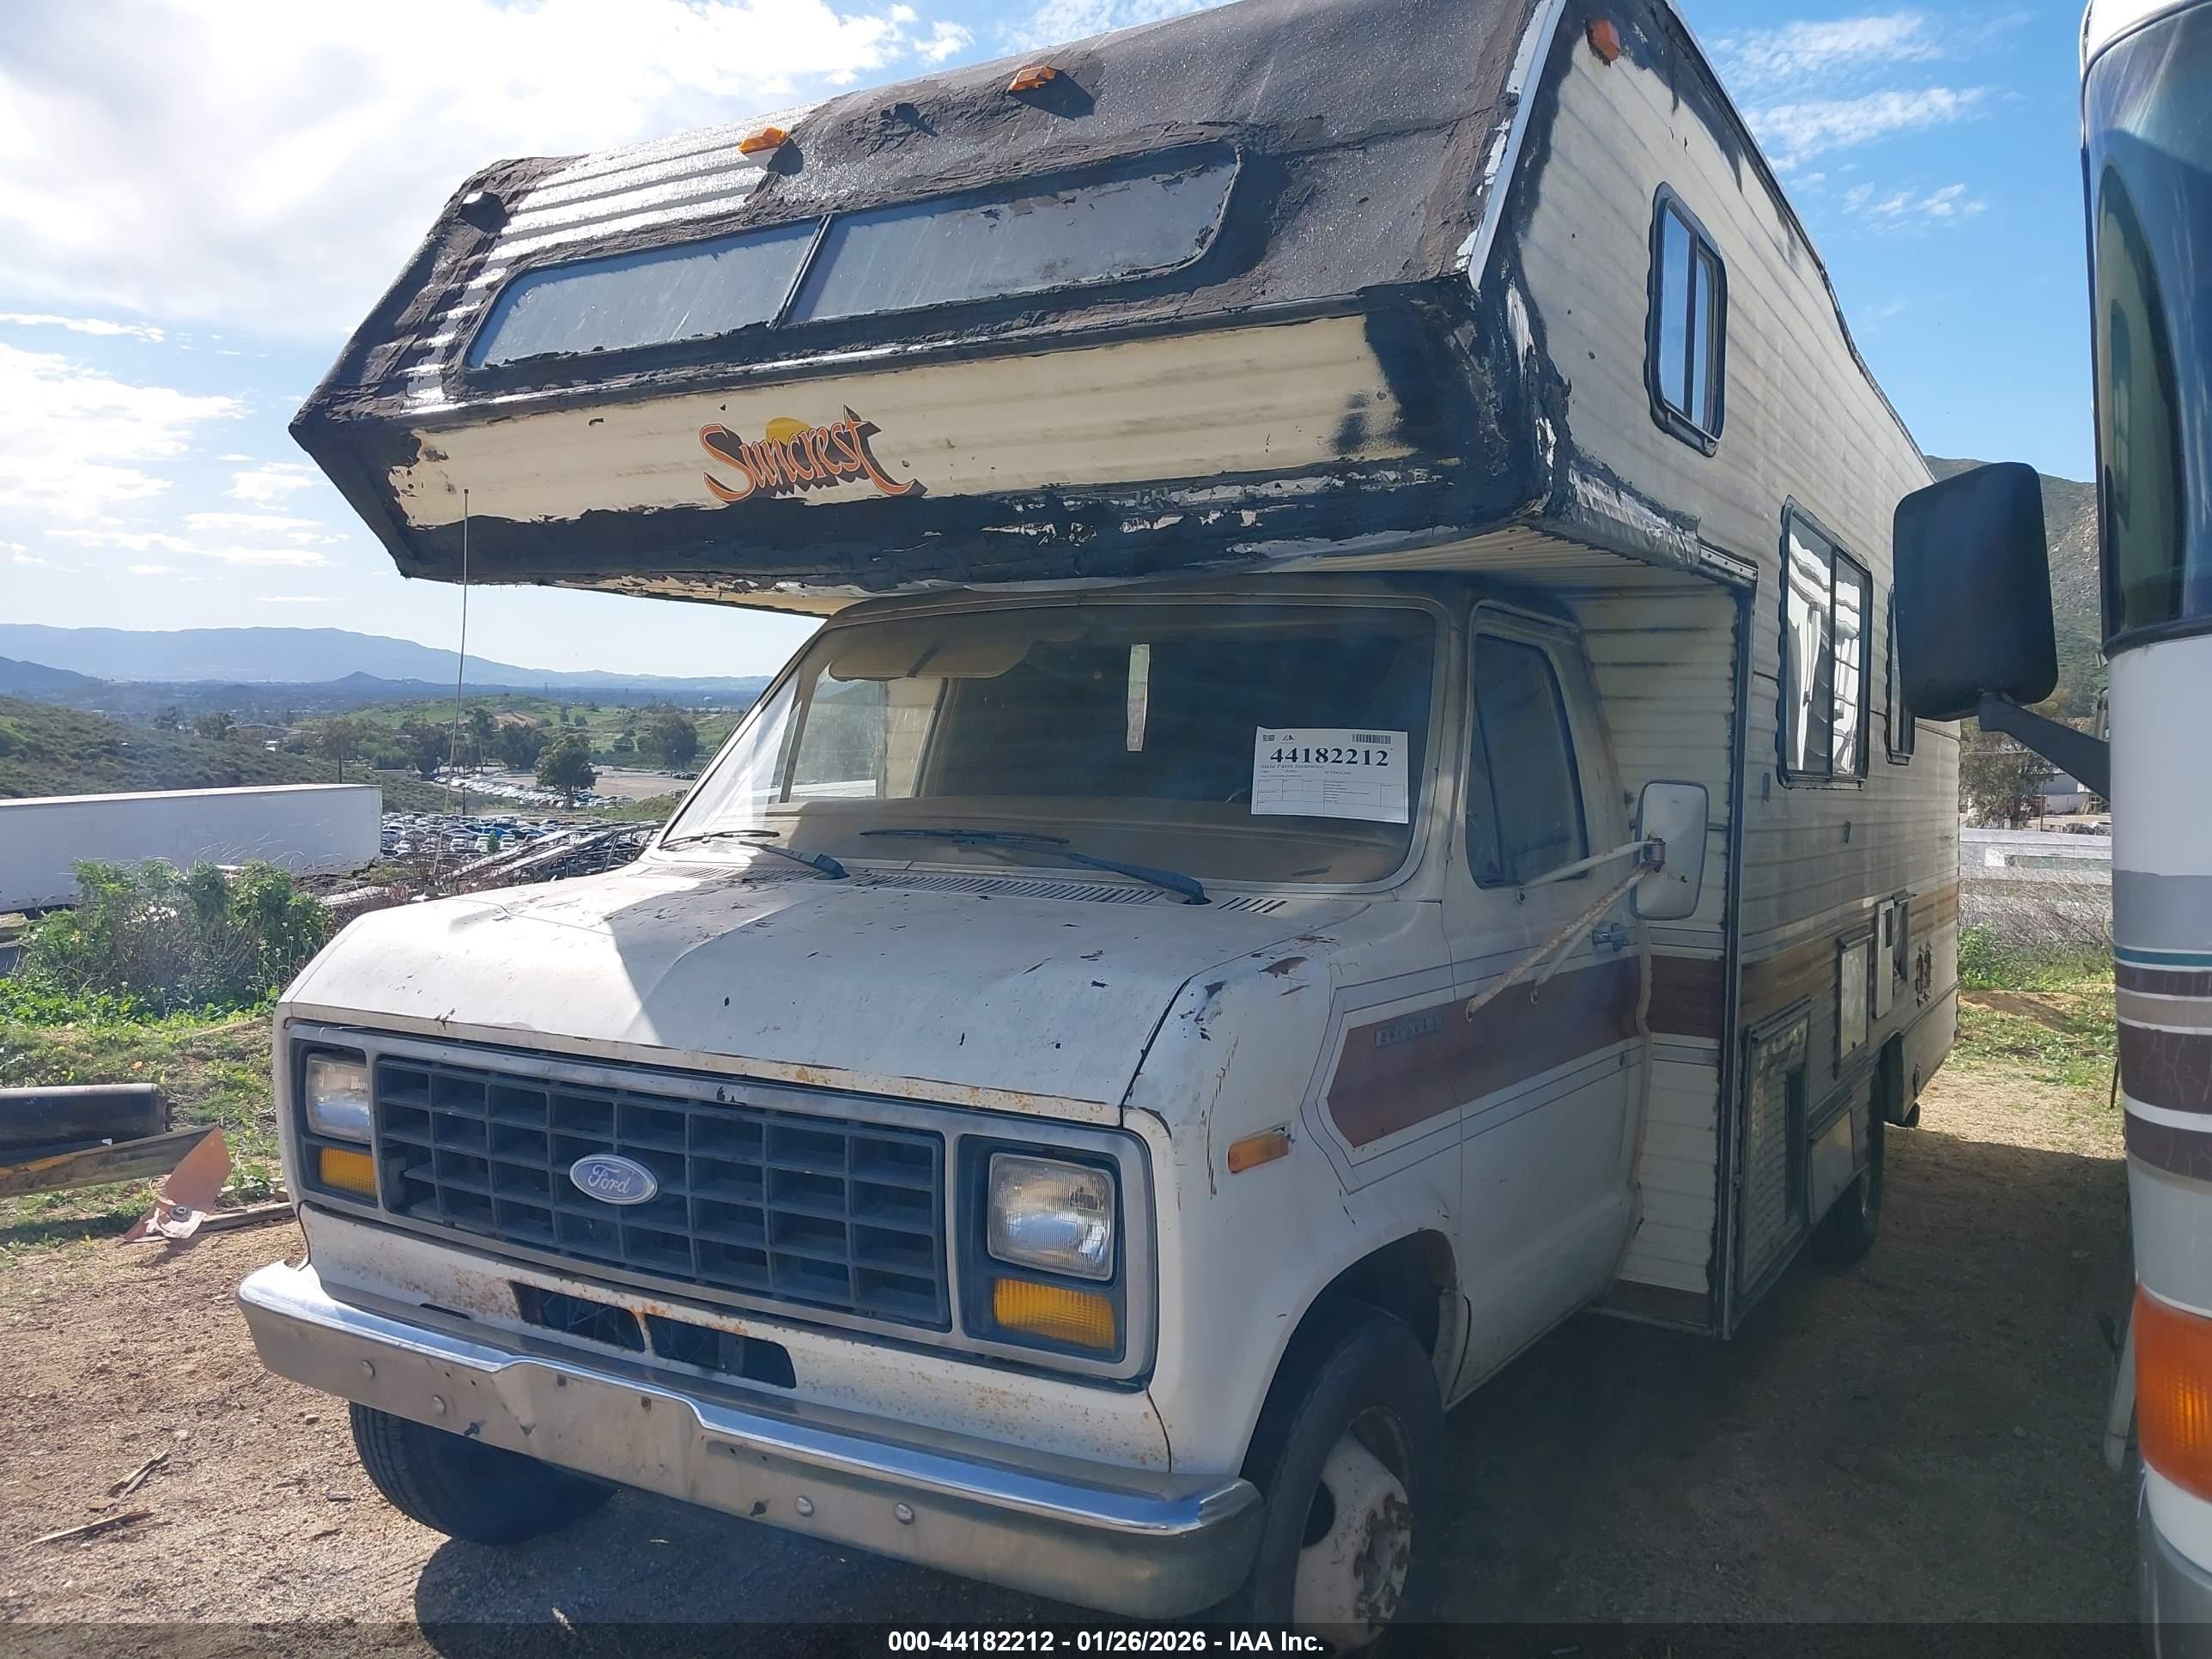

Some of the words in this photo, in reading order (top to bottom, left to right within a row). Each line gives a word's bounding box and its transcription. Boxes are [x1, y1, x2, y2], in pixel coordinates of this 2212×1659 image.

[699, 404, 922, 503] Suncrest
[1270, 747, 1389, 767] 44182212
[587, 1164, 630, 1194] Ford
